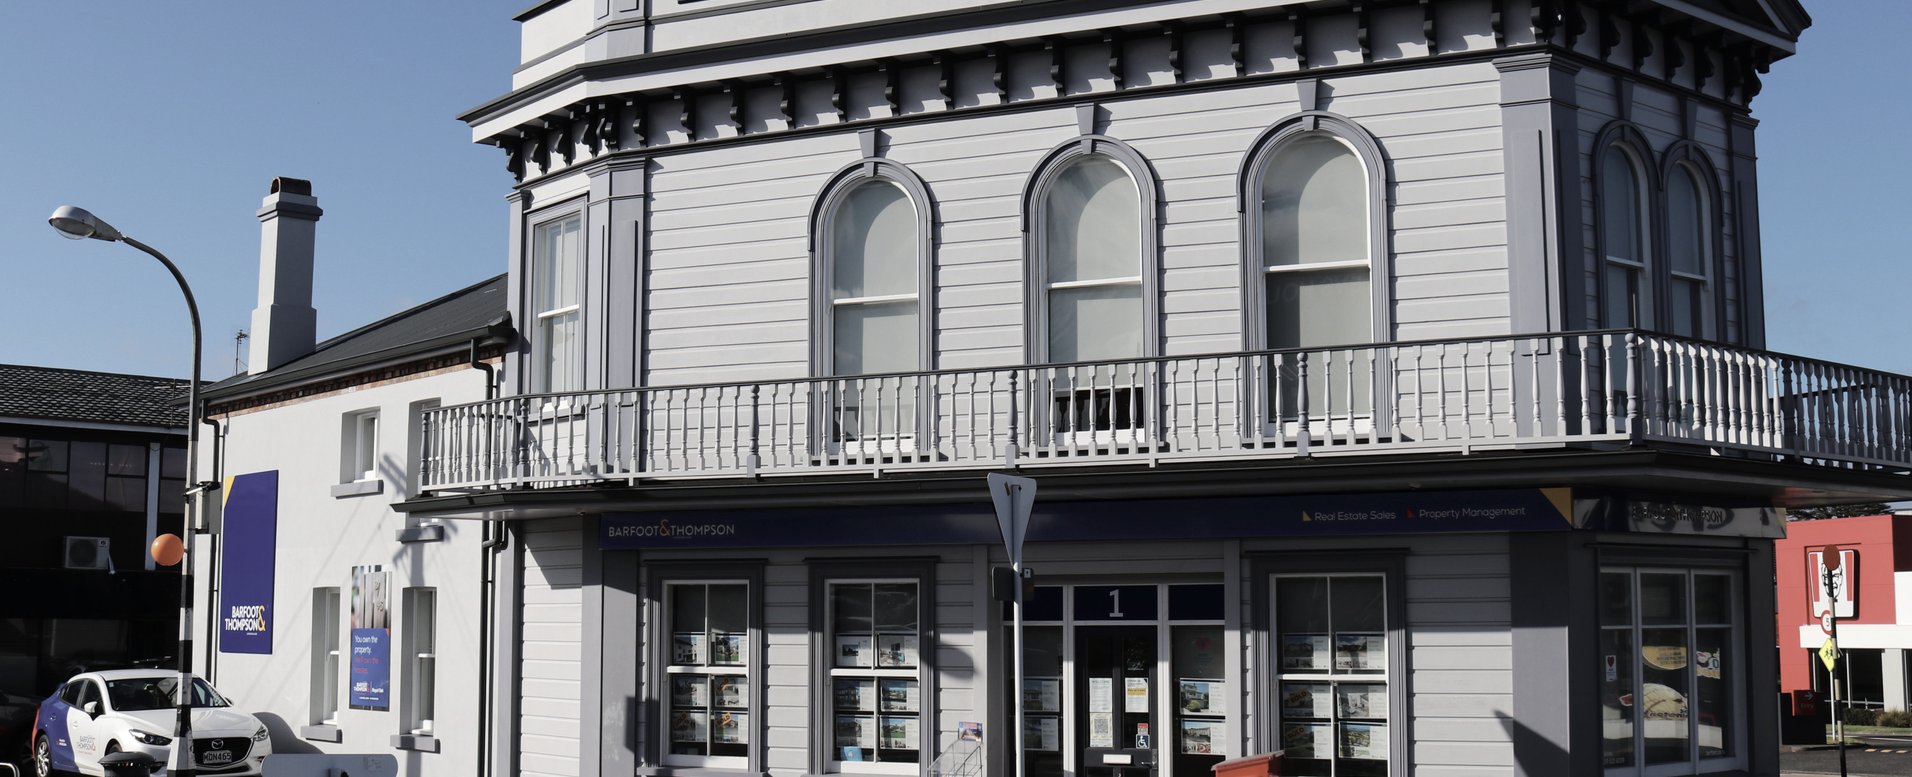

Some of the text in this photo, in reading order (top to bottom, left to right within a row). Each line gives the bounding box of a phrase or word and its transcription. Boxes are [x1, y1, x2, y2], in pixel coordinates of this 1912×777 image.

[1315, 510, 1396, 521] Real Estate Sales
[1419, 506, 1526, 520] Property Management
[1109, 589, 1124, 618] 1
[232, 605, 259, 618] BARFOOT
[225, 618, 259, 631] THOMPSON
[354, 635, 362, 644] You
[204, 752, 232, 762] MDN465
